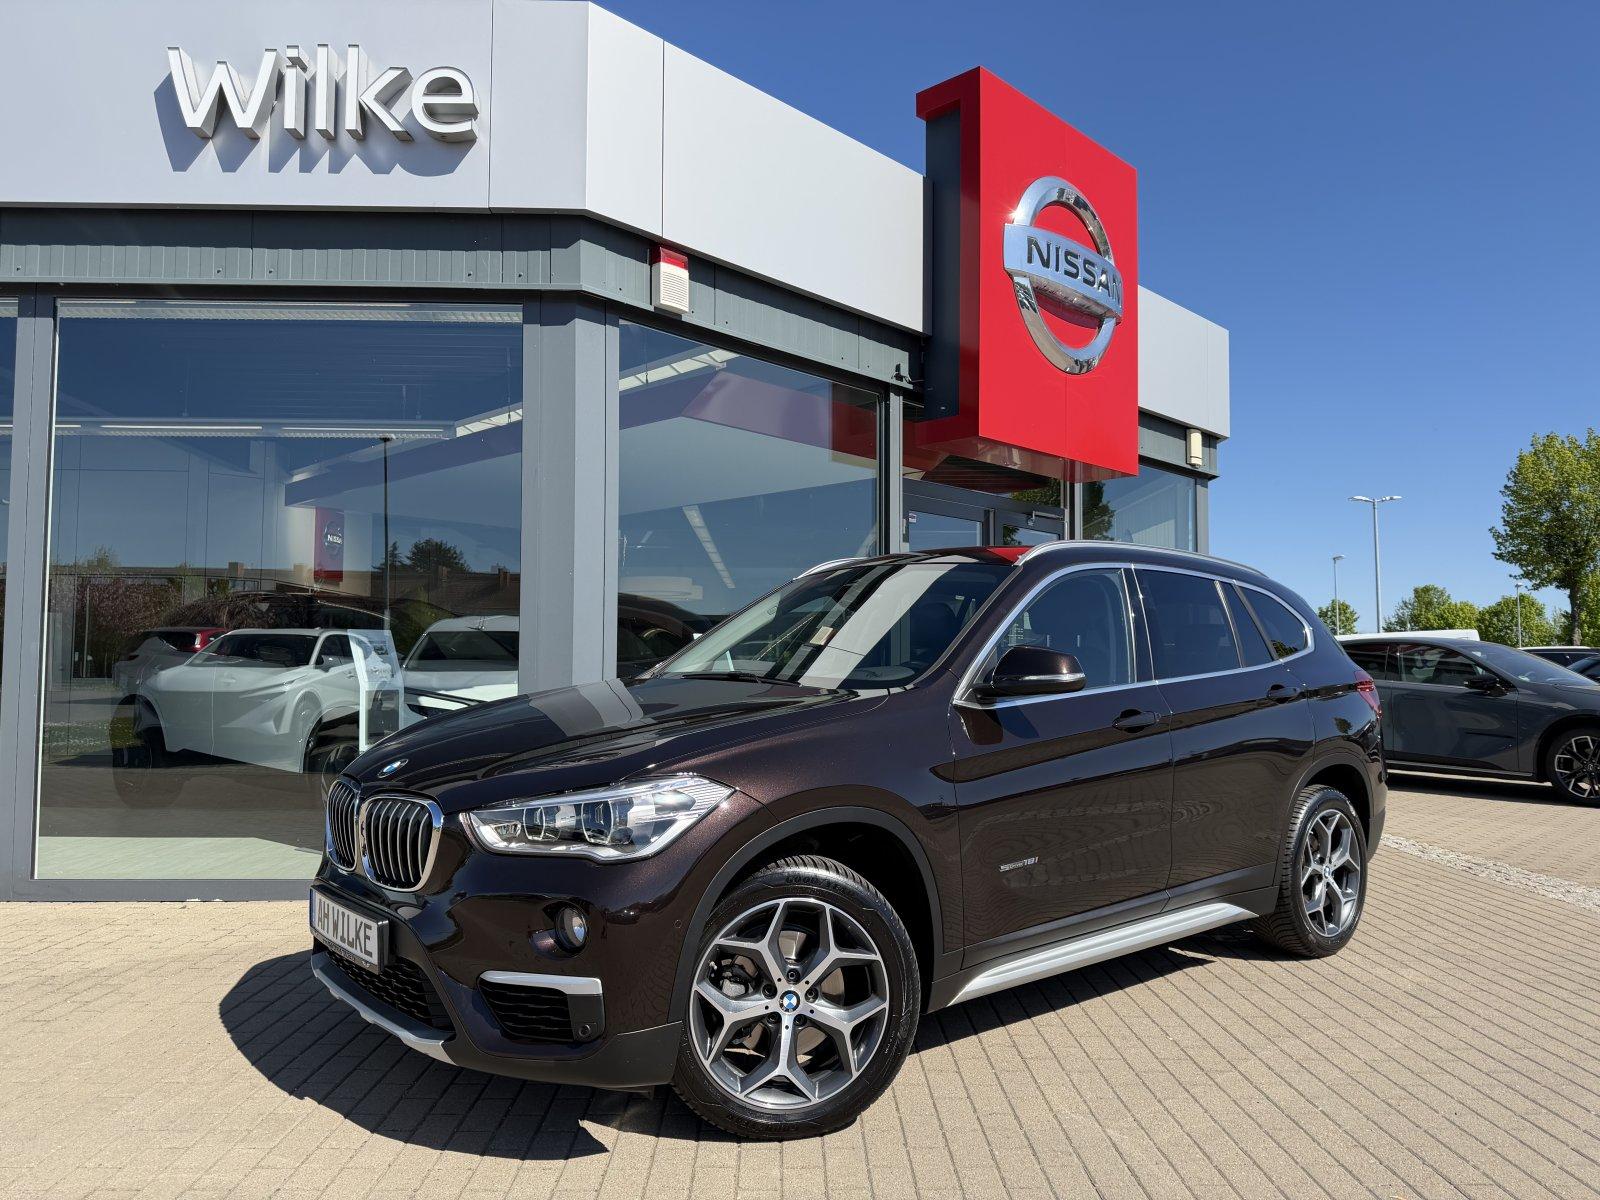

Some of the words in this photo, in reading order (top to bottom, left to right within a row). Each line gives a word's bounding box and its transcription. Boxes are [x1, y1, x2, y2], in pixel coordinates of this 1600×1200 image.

[166, 43, 479, 142] Wilke
[1026, 235, 1121, 306] NISSAN
[317, 898, 330, 934] AH
[332, 906, 373, 958] WILKE
